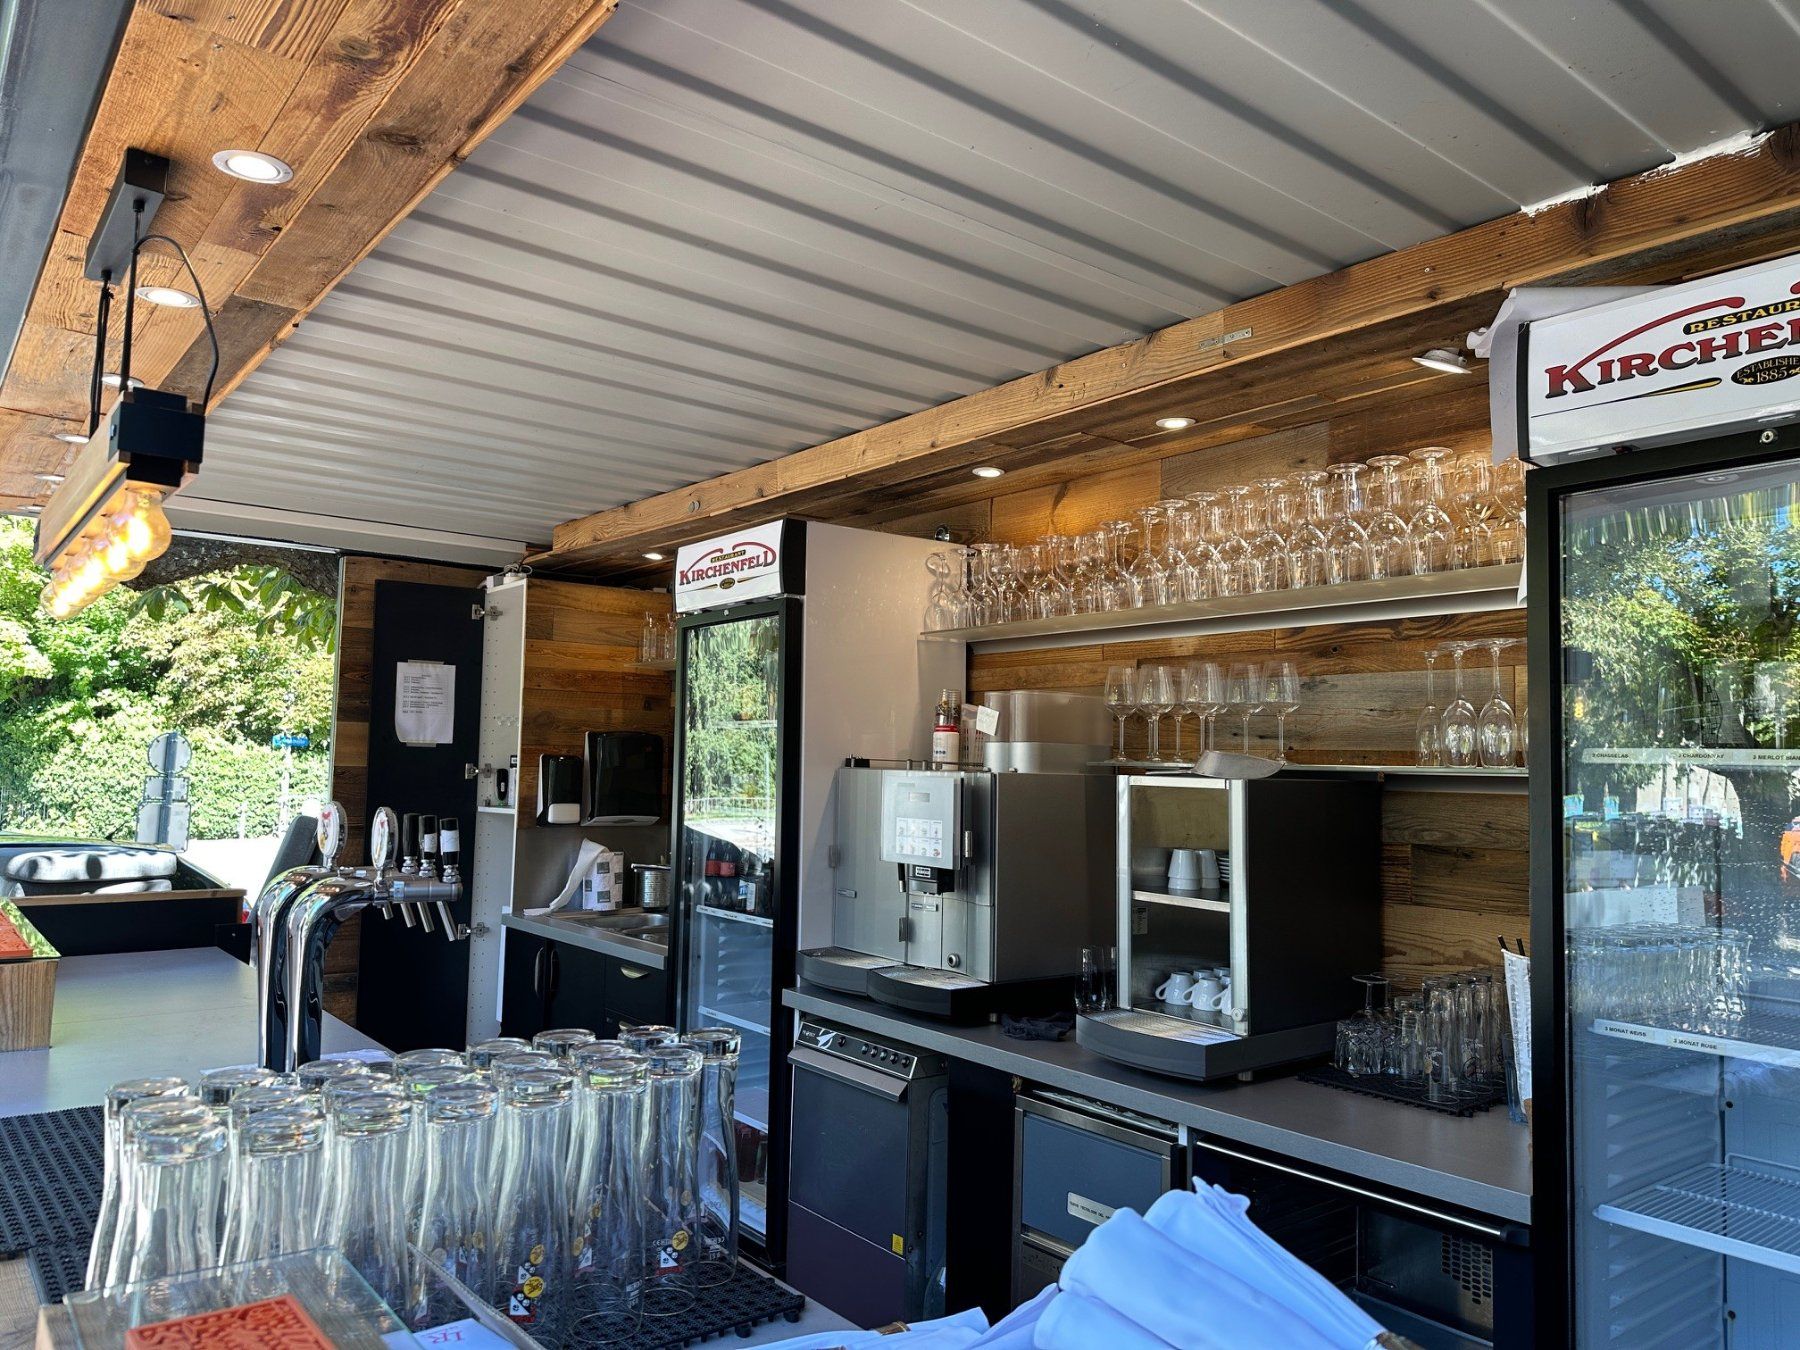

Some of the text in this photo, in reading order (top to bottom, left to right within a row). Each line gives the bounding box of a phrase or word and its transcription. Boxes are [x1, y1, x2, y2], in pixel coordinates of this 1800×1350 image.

[1689, 300, 1800, 333] RESTAUR
[1736, 356, 1800, 379] ESTABLISHE
[1757, 366, 1788, 384] 1885
[679, 549, 776, 586] KIRCHENFELD
